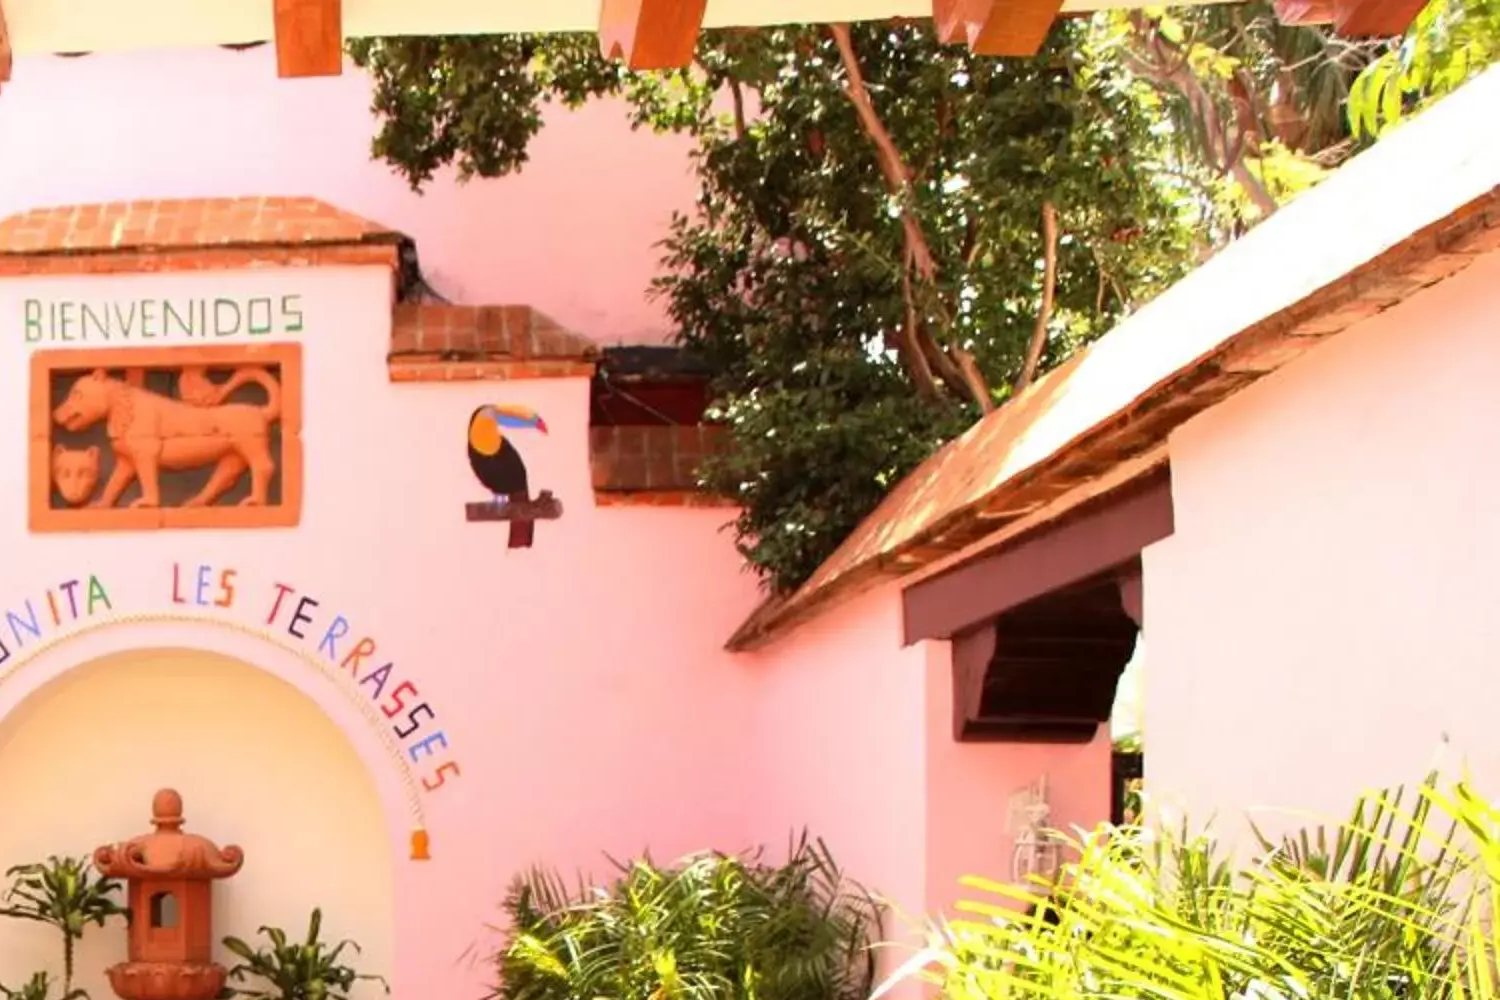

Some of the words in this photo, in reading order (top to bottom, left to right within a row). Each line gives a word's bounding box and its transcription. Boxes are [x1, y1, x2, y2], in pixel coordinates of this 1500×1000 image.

[24, 294, 303, 342] BIENVENIDOS
[172, 562, 238, 608] LES
[266, 582, 460, 792] TERRASSES
